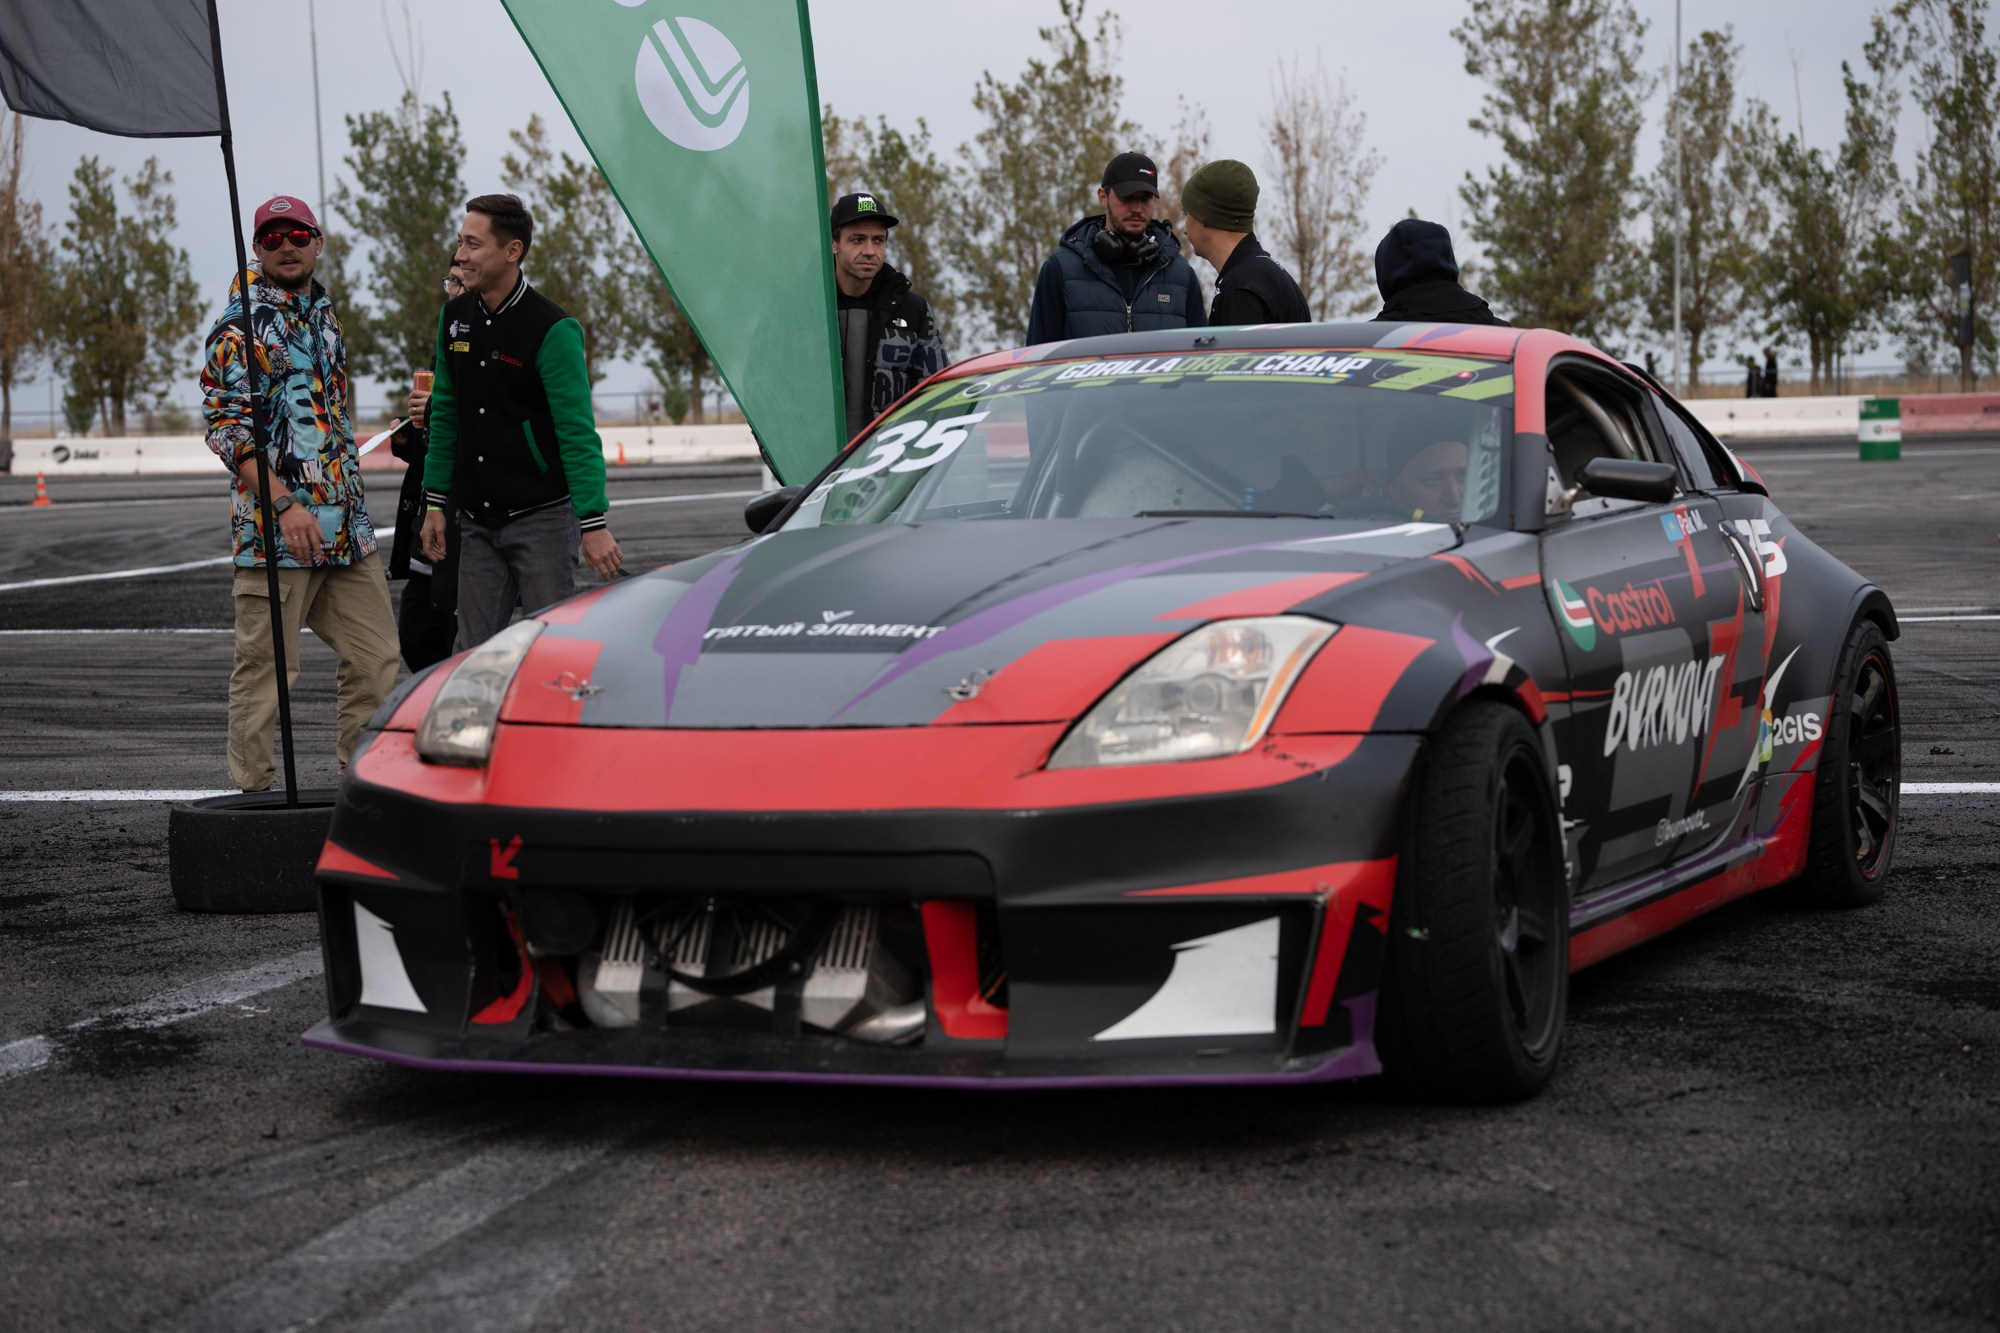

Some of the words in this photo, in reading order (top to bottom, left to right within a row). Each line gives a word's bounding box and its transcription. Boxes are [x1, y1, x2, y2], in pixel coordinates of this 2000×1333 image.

[837, 410, 991, 484] 35
[806, 623, 947, 639] ЭЛЕМЕНТ
[1586, 578, 1676, 635] Castrol
[1603, 654, 1726, 758] BURNOUT
[1772, 712, 1823, 747] 2GIS
